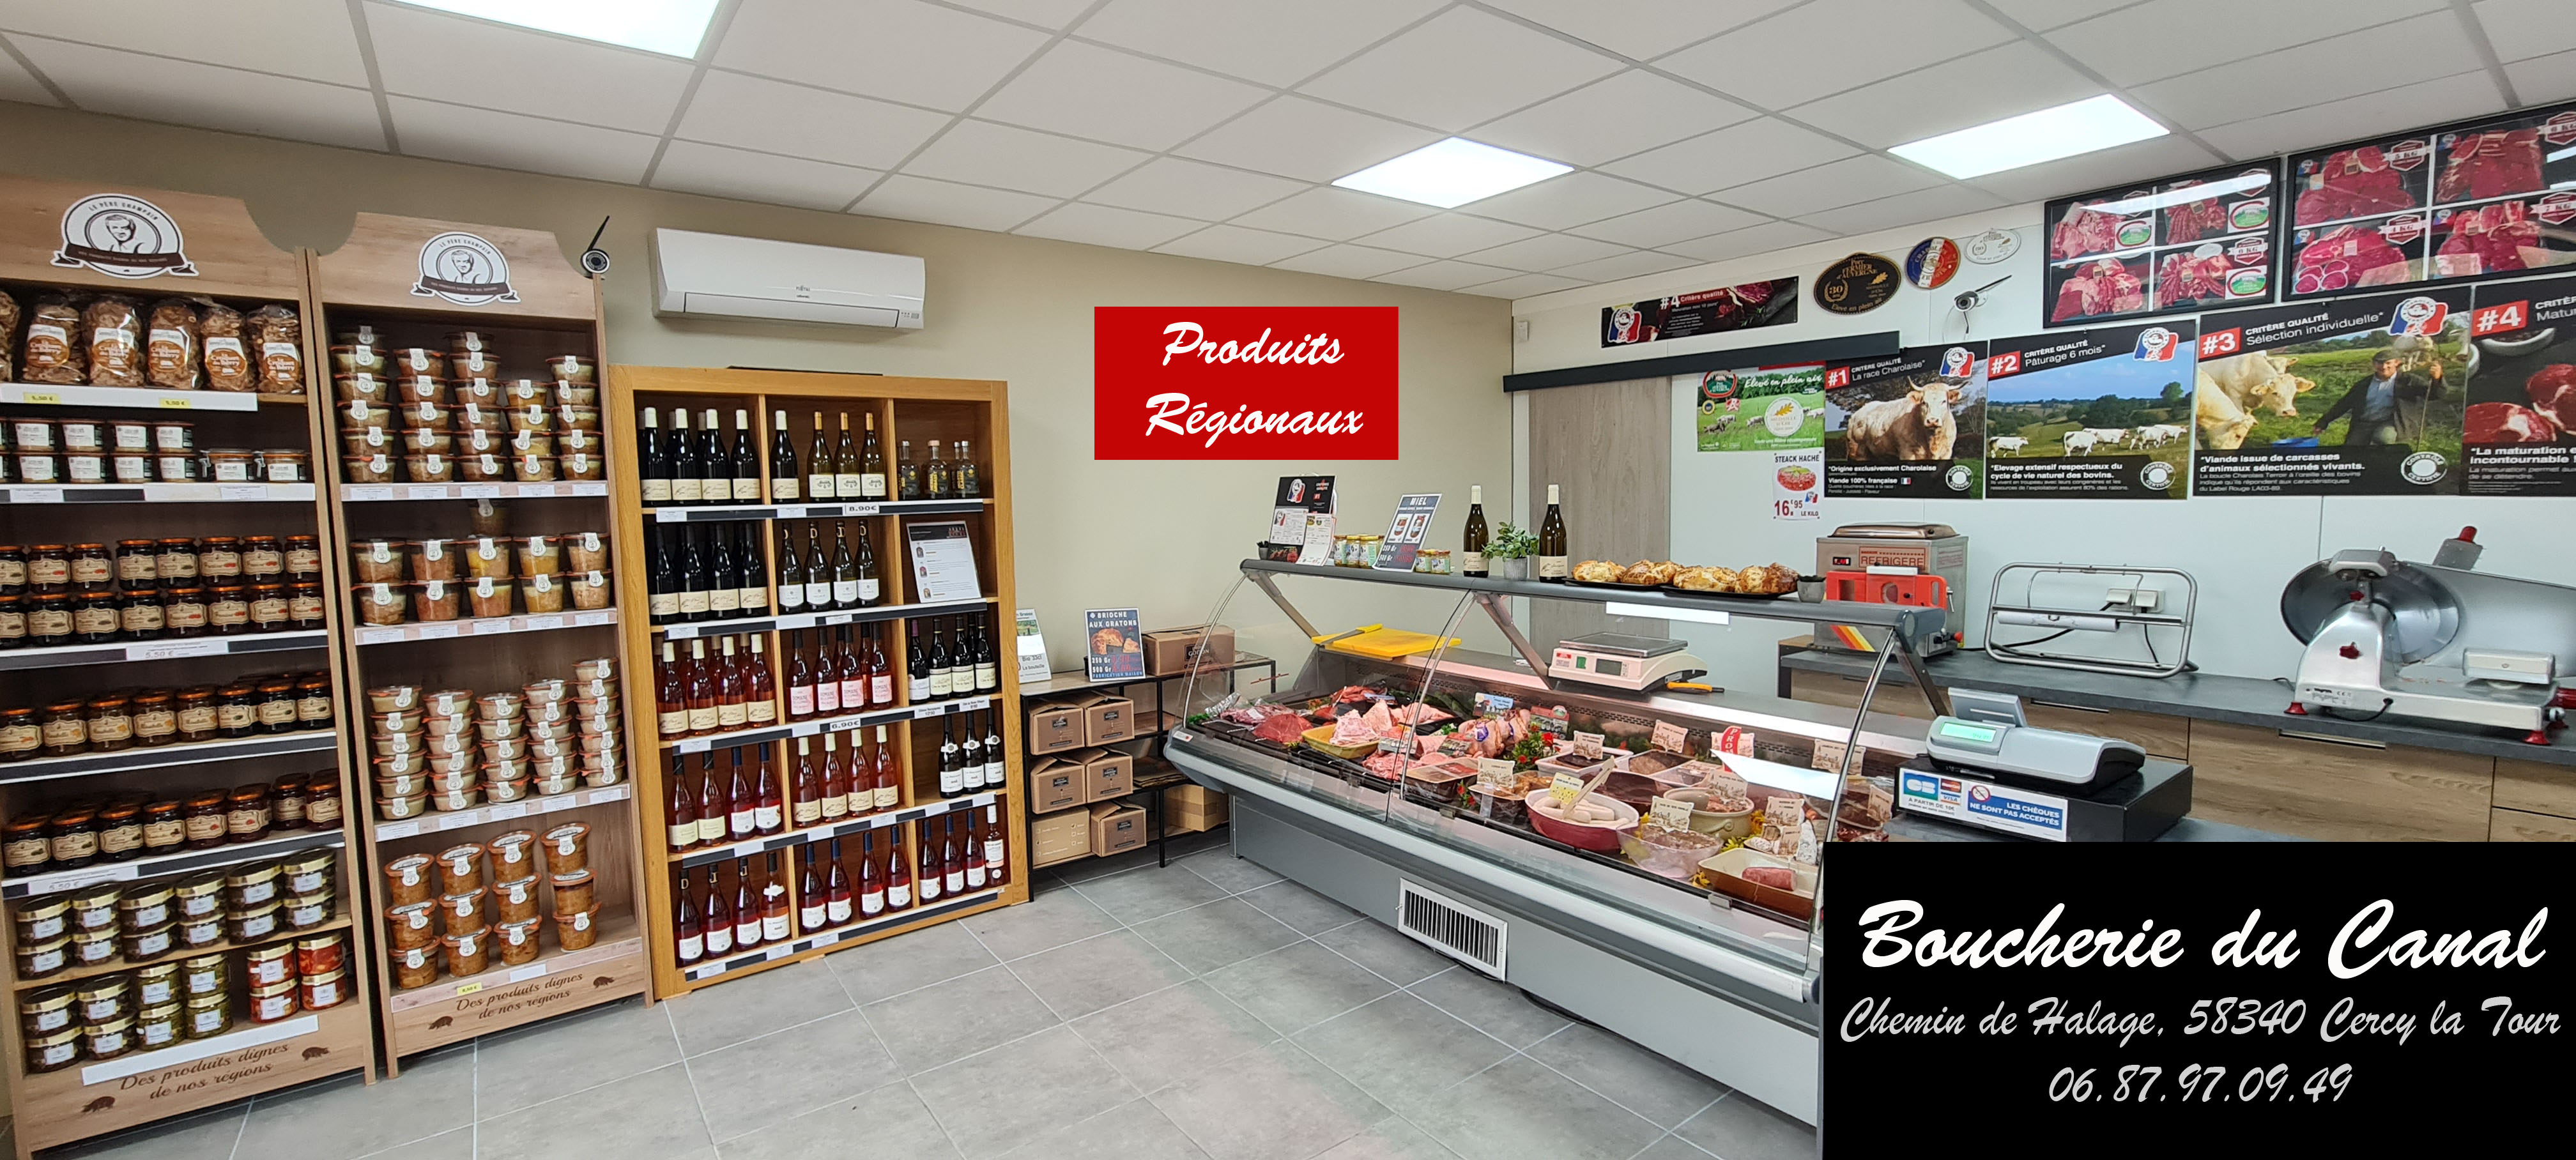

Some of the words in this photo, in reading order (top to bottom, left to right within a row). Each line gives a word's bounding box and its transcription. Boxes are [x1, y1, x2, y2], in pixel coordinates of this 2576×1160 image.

[1828, 285, 1844, 294] 30
[1660, 296, 1681, 310] #4
[2476, 305, 2522, 332] #4
[2201, 332, 2237, 355] #3
[2245, 321, 2285, 336] CRITÈRE
[2287, 312, 2329, 328] QUALITÉ
[2246, 328, 2303, 347] Sélection
[1991, 355, 2018, 375] #2
[2024, 346, 2055, 358] CRITÈRE
[2056, 339, 2089, 352] QUALITÉ
[2025, 353, 2068, 368] Pâturage
[2069, 350, 2076, 359] 6
[1828, 369, 1848, 386] #1
[1876, 357, 1902, 368] QUALITÉ
[1852, 373, 1862, 381] La
[1863, 370, 1880, 379] race
[1780, 374, 1805, 388] plein
[2239, 454, 2267, 462] issue
[2285, 453, 2340, 462] carcasses
[2494, 446, 2566, 455] maturation
[1774, 455, 1797, 463] STEACK
[2469, 455, 2570, 464] incontournable
[1900, 464, 1937, 472] Charolaise
[2025, 463, 2057, 471] extensif
[2058, 463, 2110, 473] respectueux
[2200, 464, 2251, 473] d'animaux
[2253, 463, 2319, 472] sélectionnés
[2321, 462, 2366, 471] vivants.
[1867, 477, 1898, 485] française
[1990, 471, 2011, 480] cycle
[2083, 471, 2115, 479] bovins.
[1409, 497, 1427, 506] MIEL
[1906, 779, 1936, 795] CB
[1914, 798, 1935, 807] PARTIR
[1981, 804, 2003, 814] SONT
[2003, 809, 2019, 818] PAS
[2020, 811, 2060, 827] ACCEPTÉS
[2006, 802, 2021, 811] LES
[2021, 804, 2060, 819] CHÈQUES
[680, 878, 689, 890] D
[456, 996, 484, 1012] Des
[486, 983, 540, 1008] produits
[544, 972, 584, 991] dignes
[478, 1007, 494, 1021] de
[497, 1002, 522, 1014] nos
[526, 989, 572, 1009] régions
[119, 1072, 157, 1092] Des
[162, 1056, 232, 1085] produits
[237, 1042, 290, 1069] dignes
[149, 1085, 172, 1101] de
[176, 1078, 208, 1094] nos
[214, 1061, 275, 1087] régions
